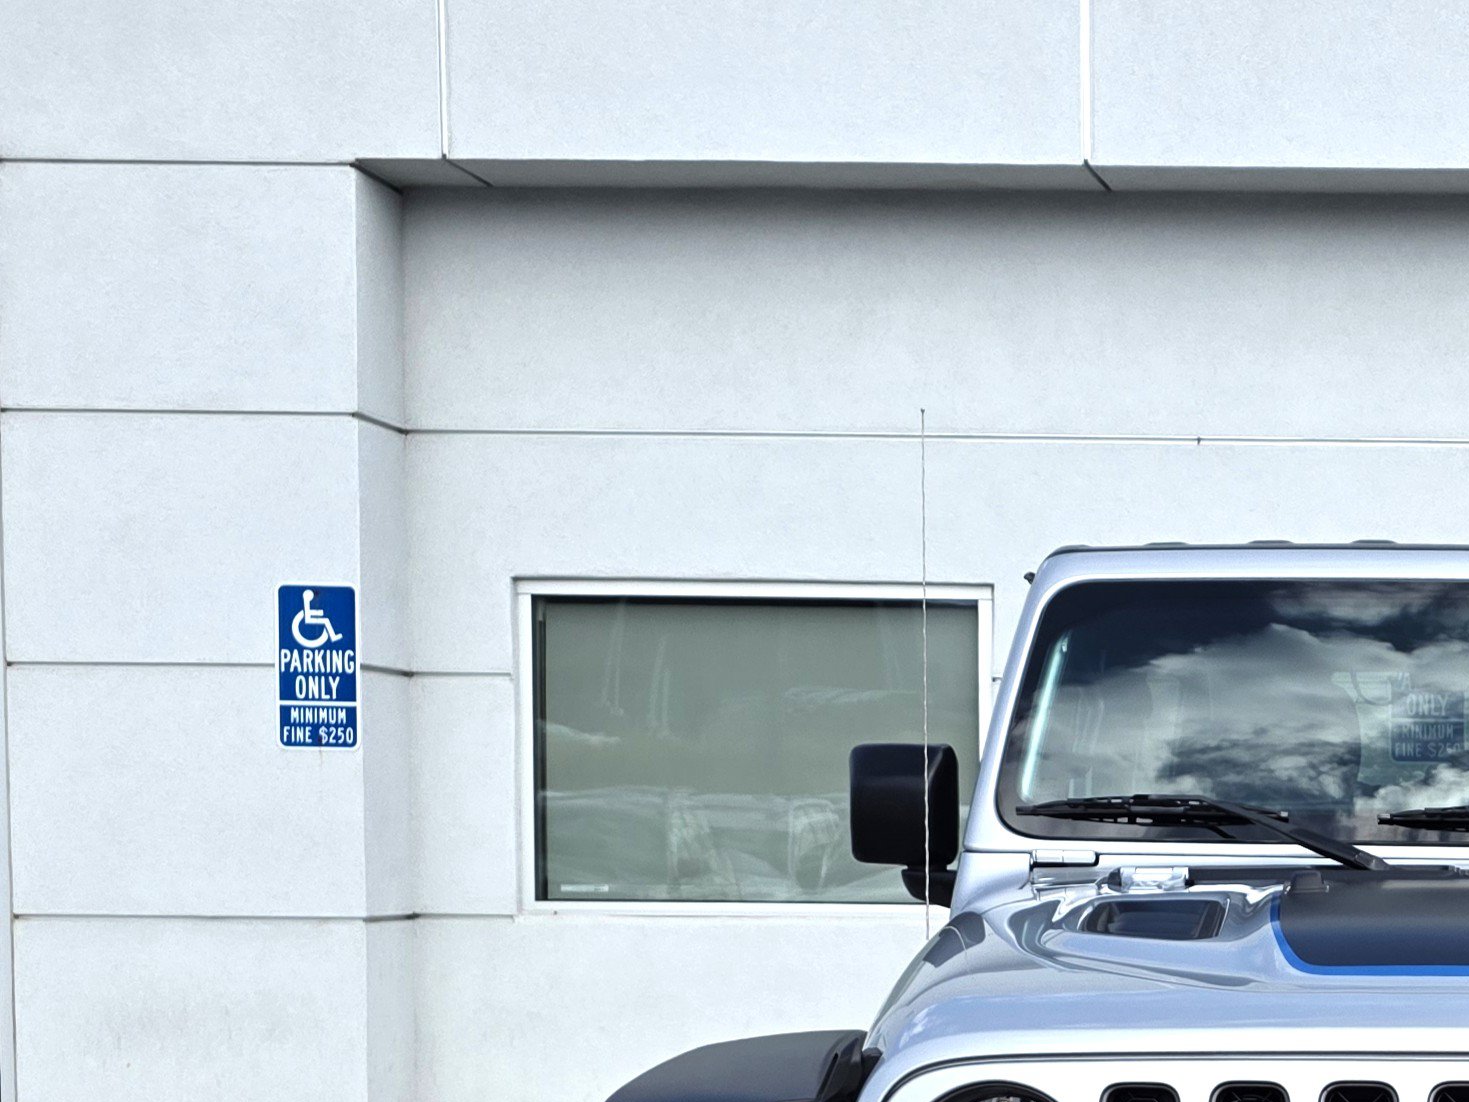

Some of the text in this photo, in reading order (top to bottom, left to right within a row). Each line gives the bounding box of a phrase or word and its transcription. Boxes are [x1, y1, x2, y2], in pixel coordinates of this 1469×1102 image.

[280, 648, 355, 674] PARKING
[295, 675, 340, 700] ONLY
[290, 706, 347, 725] MINIMUM
[1406, 693, 1449, 716] ONLY
[283, 726, 354, 744] FINE $250
